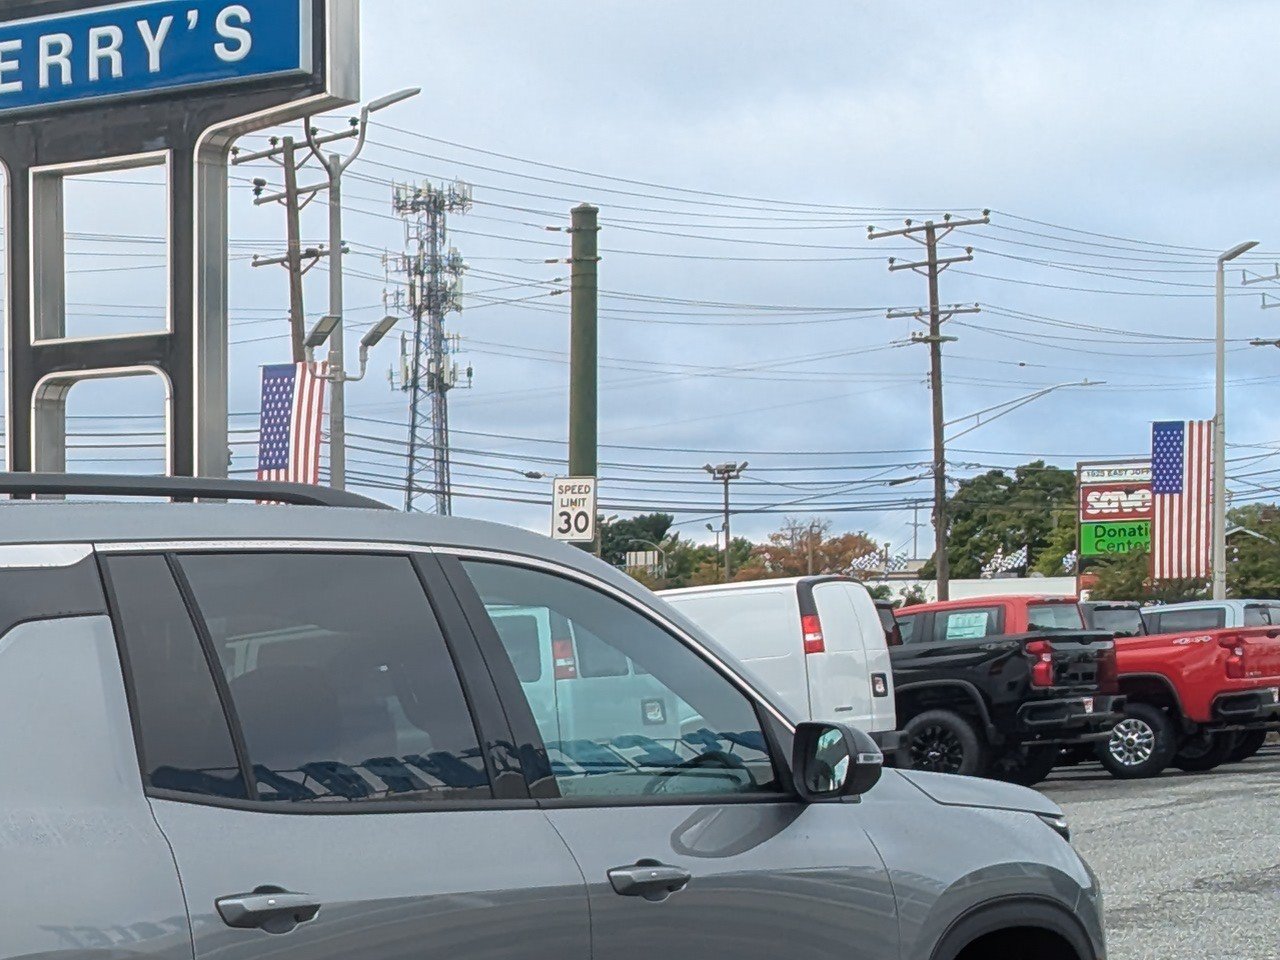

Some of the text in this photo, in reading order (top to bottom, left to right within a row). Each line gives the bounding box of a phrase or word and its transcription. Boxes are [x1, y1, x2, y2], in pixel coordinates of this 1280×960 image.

[558, 484, 591, 494] SPEED
[561, 498, 587, 507] LIMIT
[557, 511, 589, 534] 30
[1094, 523, 1151, 538] Donati
